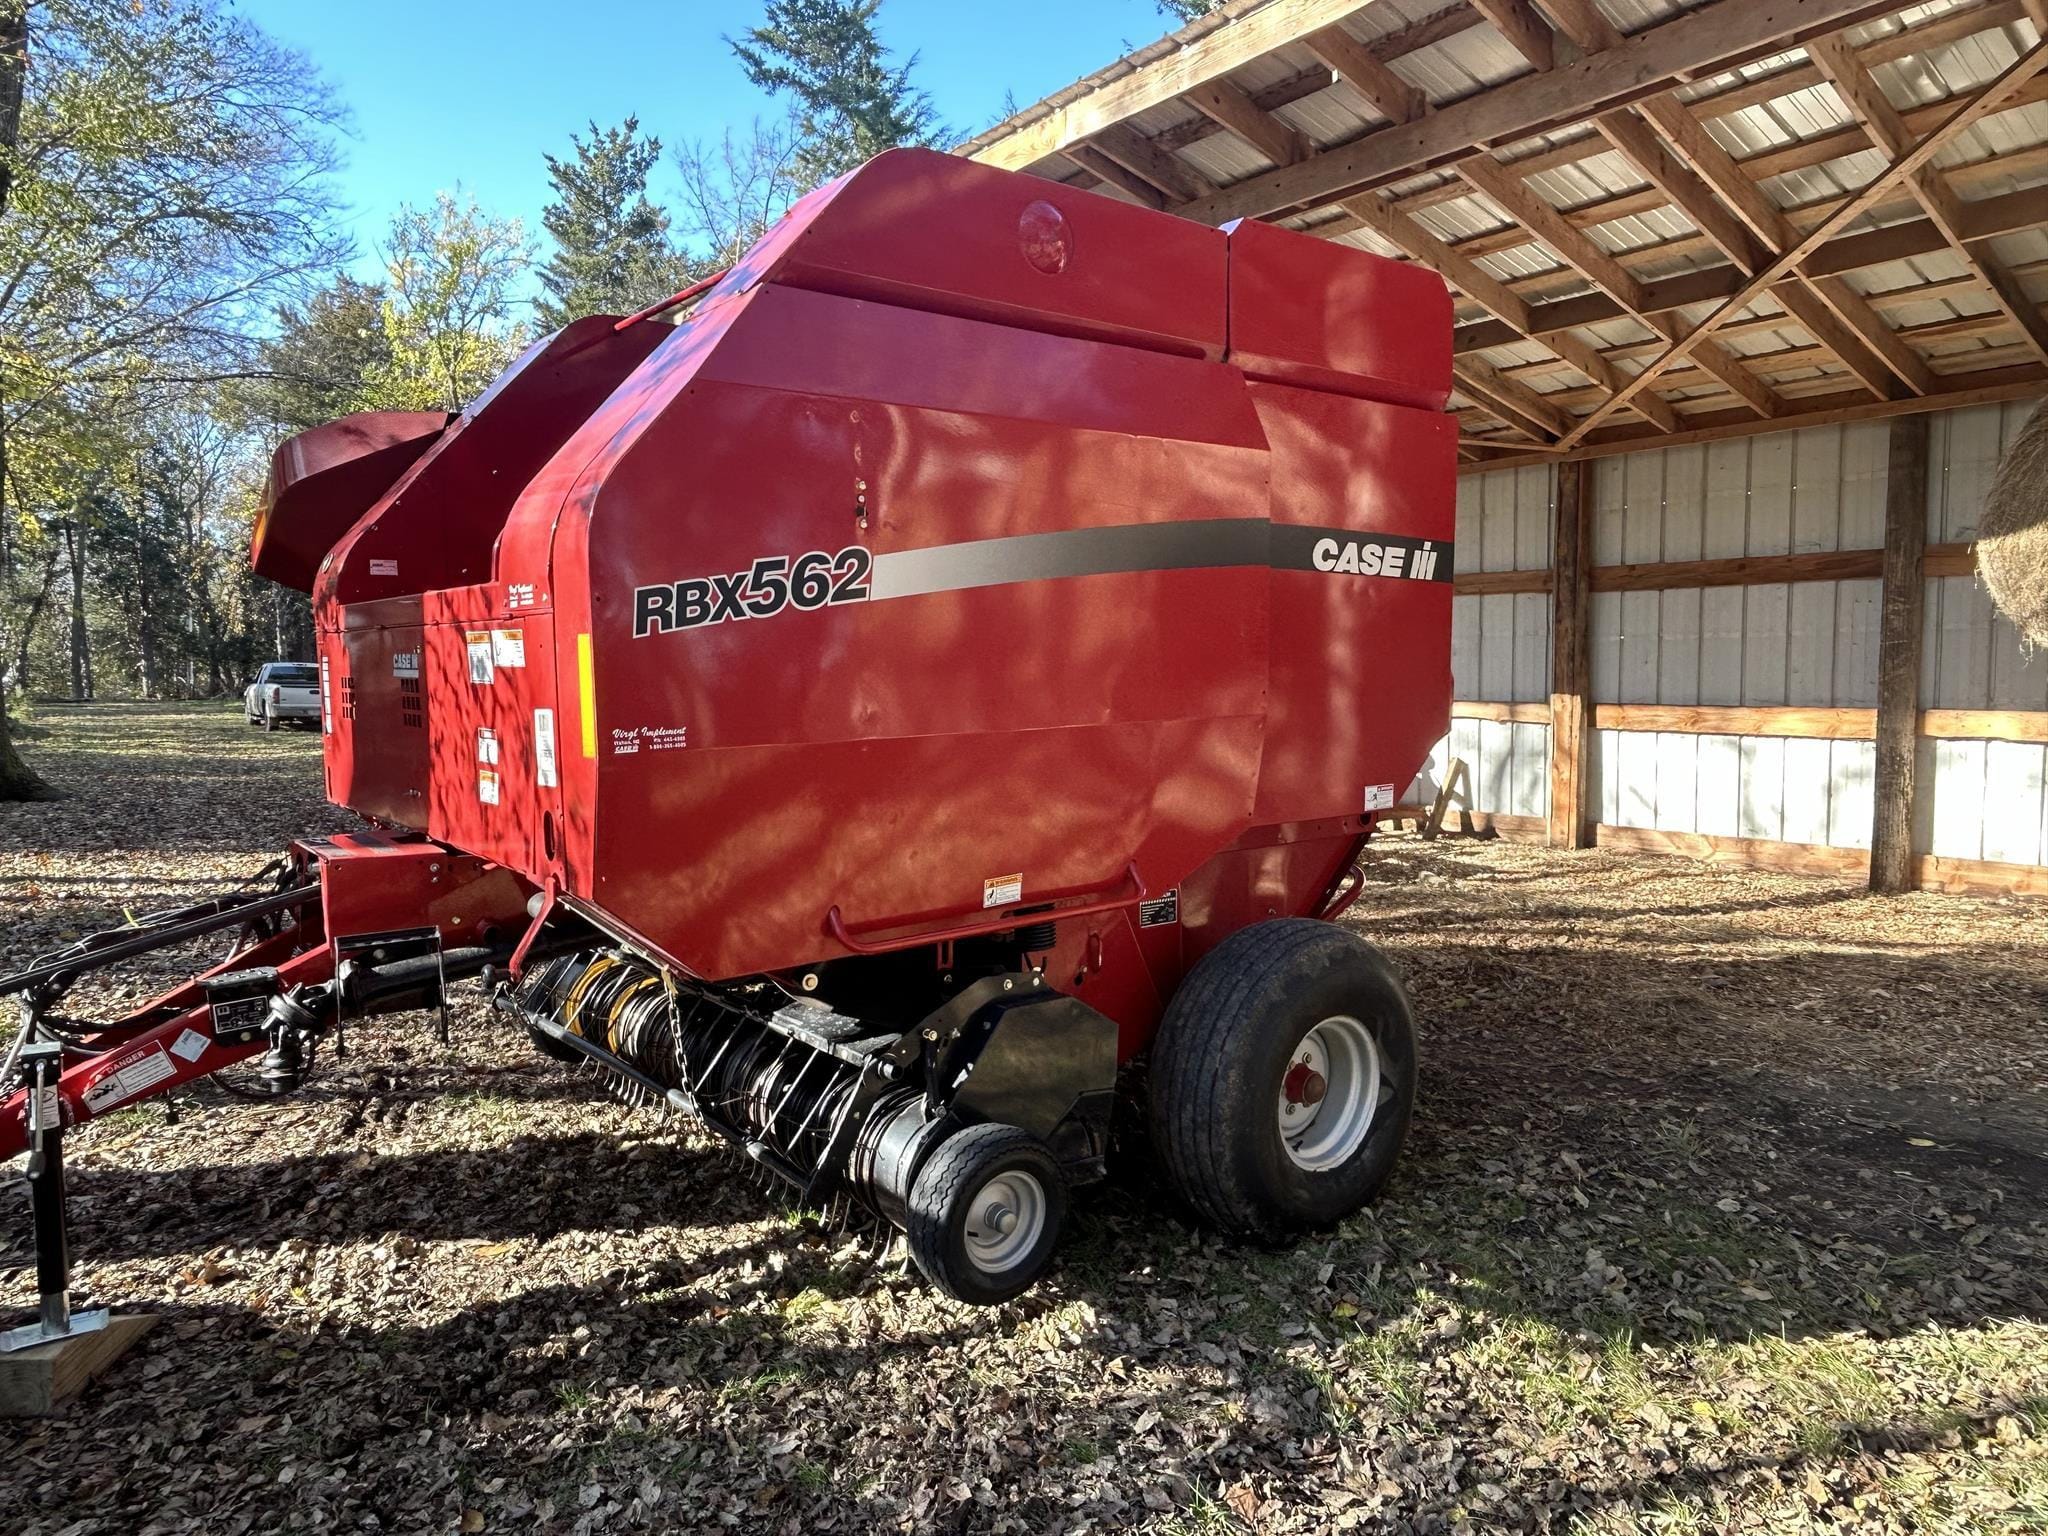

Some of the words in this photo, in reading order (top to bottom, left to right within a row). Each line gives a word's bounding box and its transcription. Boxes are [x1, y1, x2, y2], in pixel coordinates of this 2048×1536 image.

[1312, 538, 1406, 578] CASE
[632, 545, 873, 639] RBX562
[393, 653, 412, 669] CASE
[641, 726, 687, 738] Implement
[106, 1051, 146, 1074] DANGER
